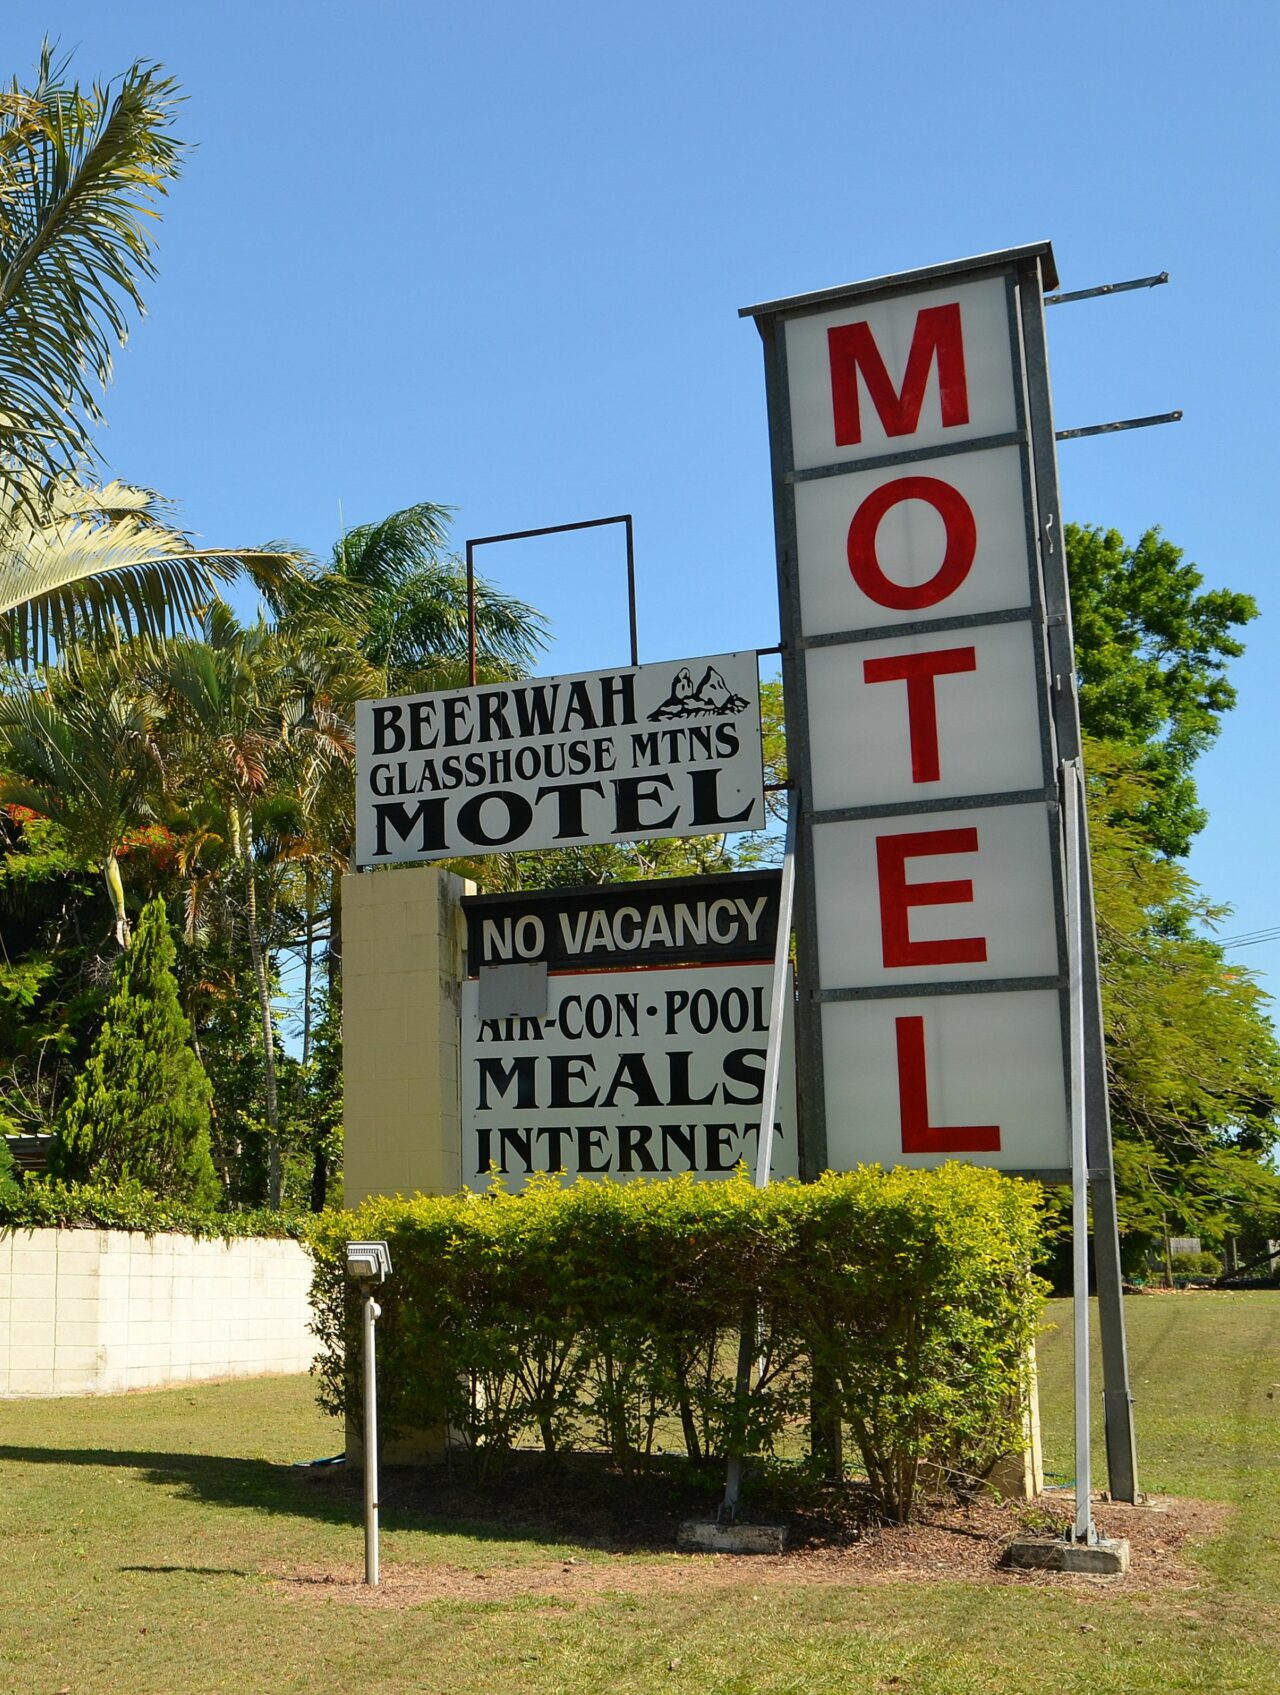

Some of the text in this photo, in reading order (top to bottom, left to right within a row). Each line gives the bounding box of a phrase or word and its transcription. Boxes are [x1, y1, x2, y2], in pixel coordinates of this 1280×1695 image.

[371, 673, 637, 756] BEERWAH
[827, 302, 1001, 1154] MOTEL
[370, 722, 740, 797] GLASSHOUSE MTNS
[372, 767, 756, 857] MOTEL
[482, 896, 769, 961] NO VACANCY
[664, 986, 770, 1035] POOL
[474, 1048, 778, 1111] MEALS
[475, 1122, 784, 1174] INTERNET
